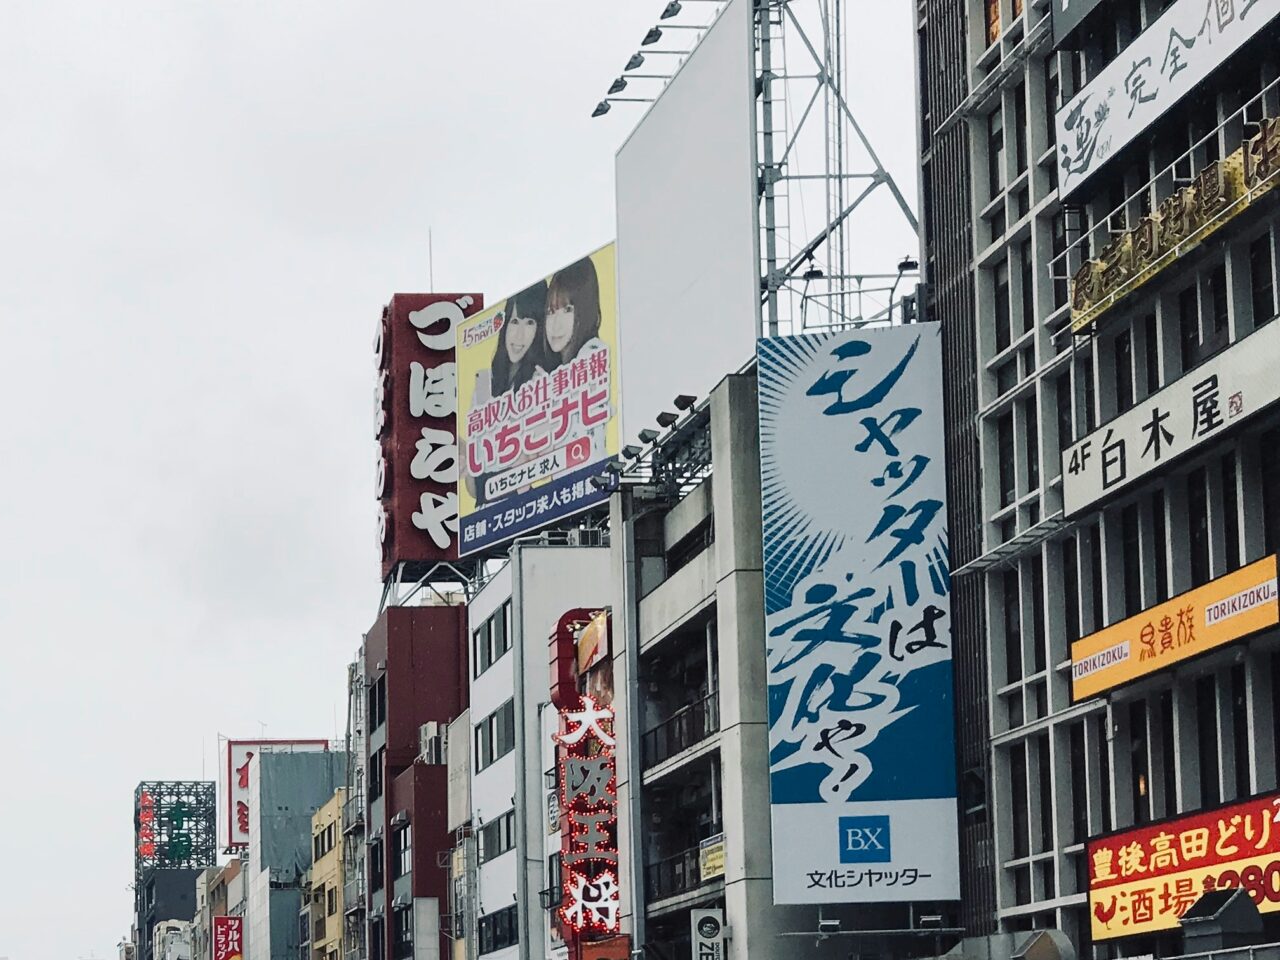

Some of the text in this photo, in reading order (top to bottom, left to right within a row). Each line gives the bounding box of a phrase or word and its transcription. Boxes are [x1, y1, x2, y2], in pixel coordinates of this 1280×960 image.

[467, 348, 608, 437] 高収入お仕事情報
[467, 380, 609, 476] いちごナビ
[1068, 374, 1224, 491] 4F 白木屋
[488, 456, 561, 496] いちごナビ 求人
[1073, 585, 1271, 679] TORIKIZOKU 鳥貴族 TORIKIZOKU
[552, 697, 618, 933] 大阪王将
[846, 827, 884, 851] BX
[1090, 807, 1271, 885] 豊後高田どり
[227, 918, 239, 953] ツルハ
[1122, 875, 1199, 926] 酒場
[216, 924, 227, 960] ドラッグ
